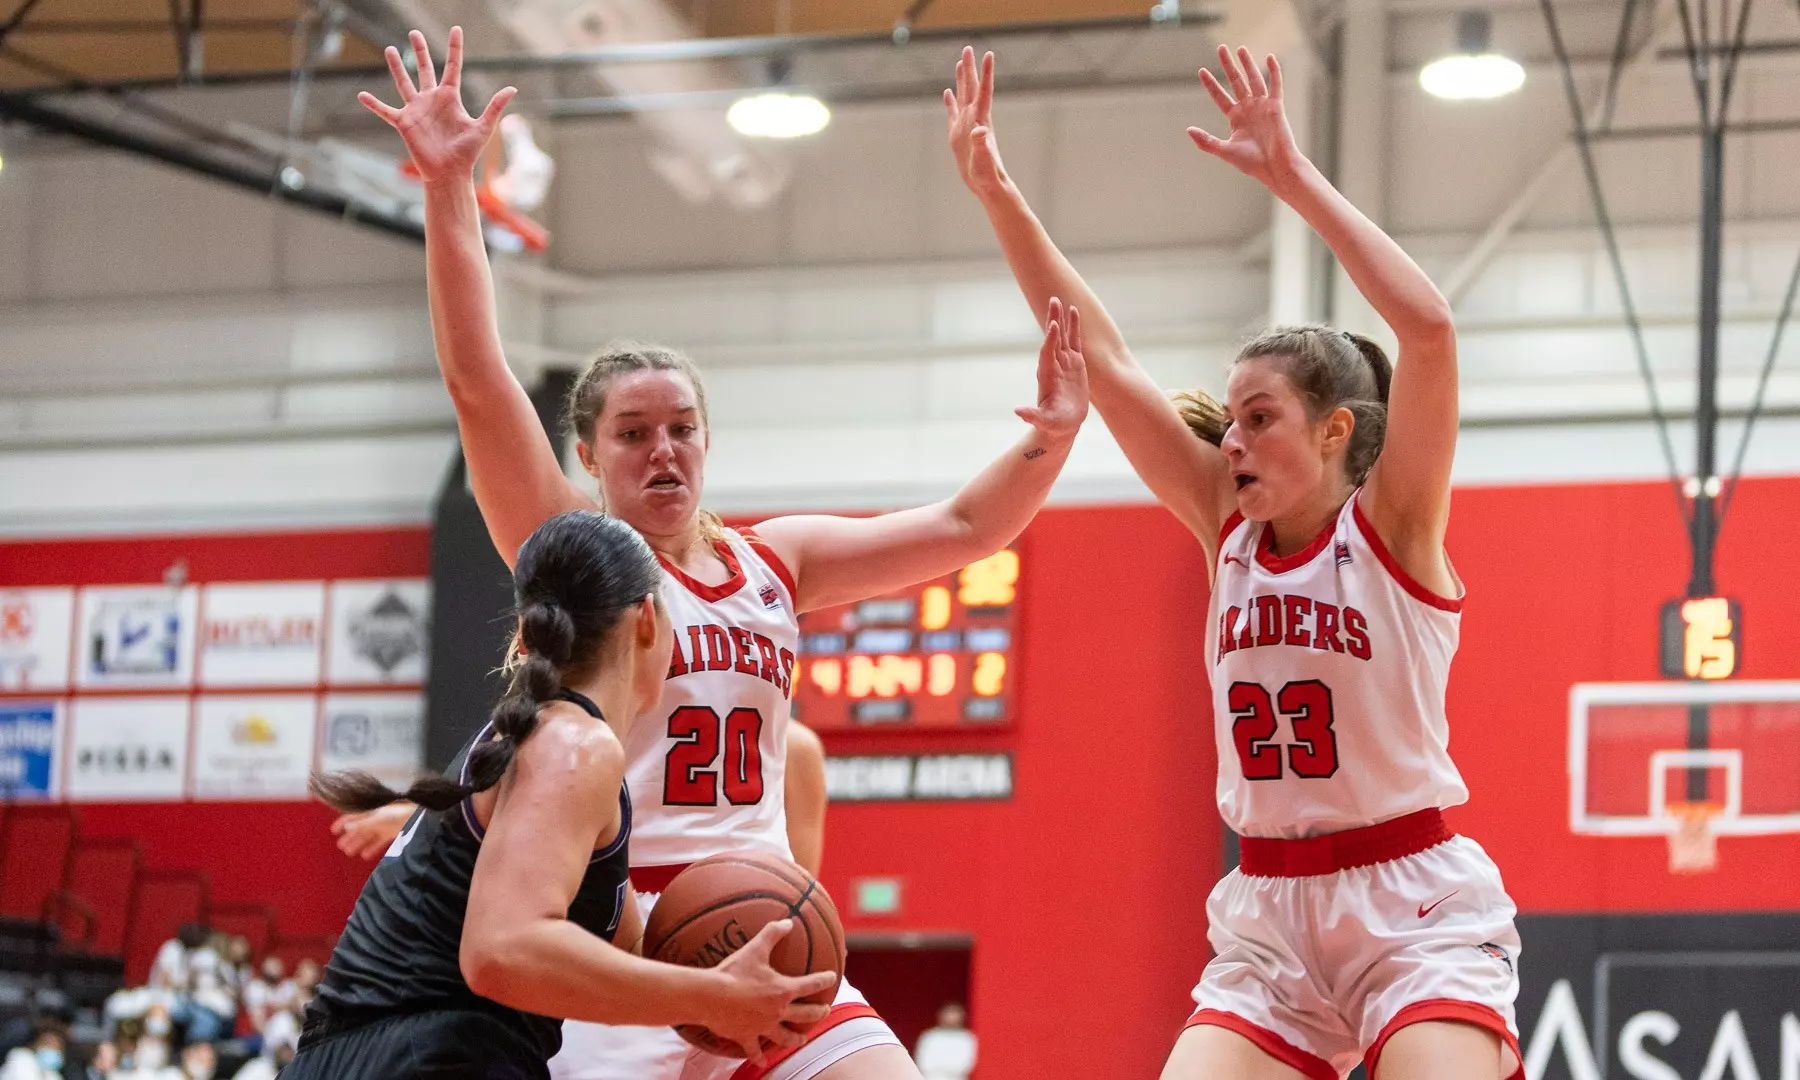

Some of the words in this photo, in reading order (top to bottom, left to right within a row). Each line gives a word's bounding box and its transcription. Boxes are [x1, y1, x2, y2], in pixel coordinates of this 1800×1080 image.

[665, 623, 796, 700] AIDERS
[1217, 594, 1372, 666] AIDERS
[662, 705, 764, 806] 20
[1228, 678, 1339, 781] 23
[694, 918, 752, 969] ING
